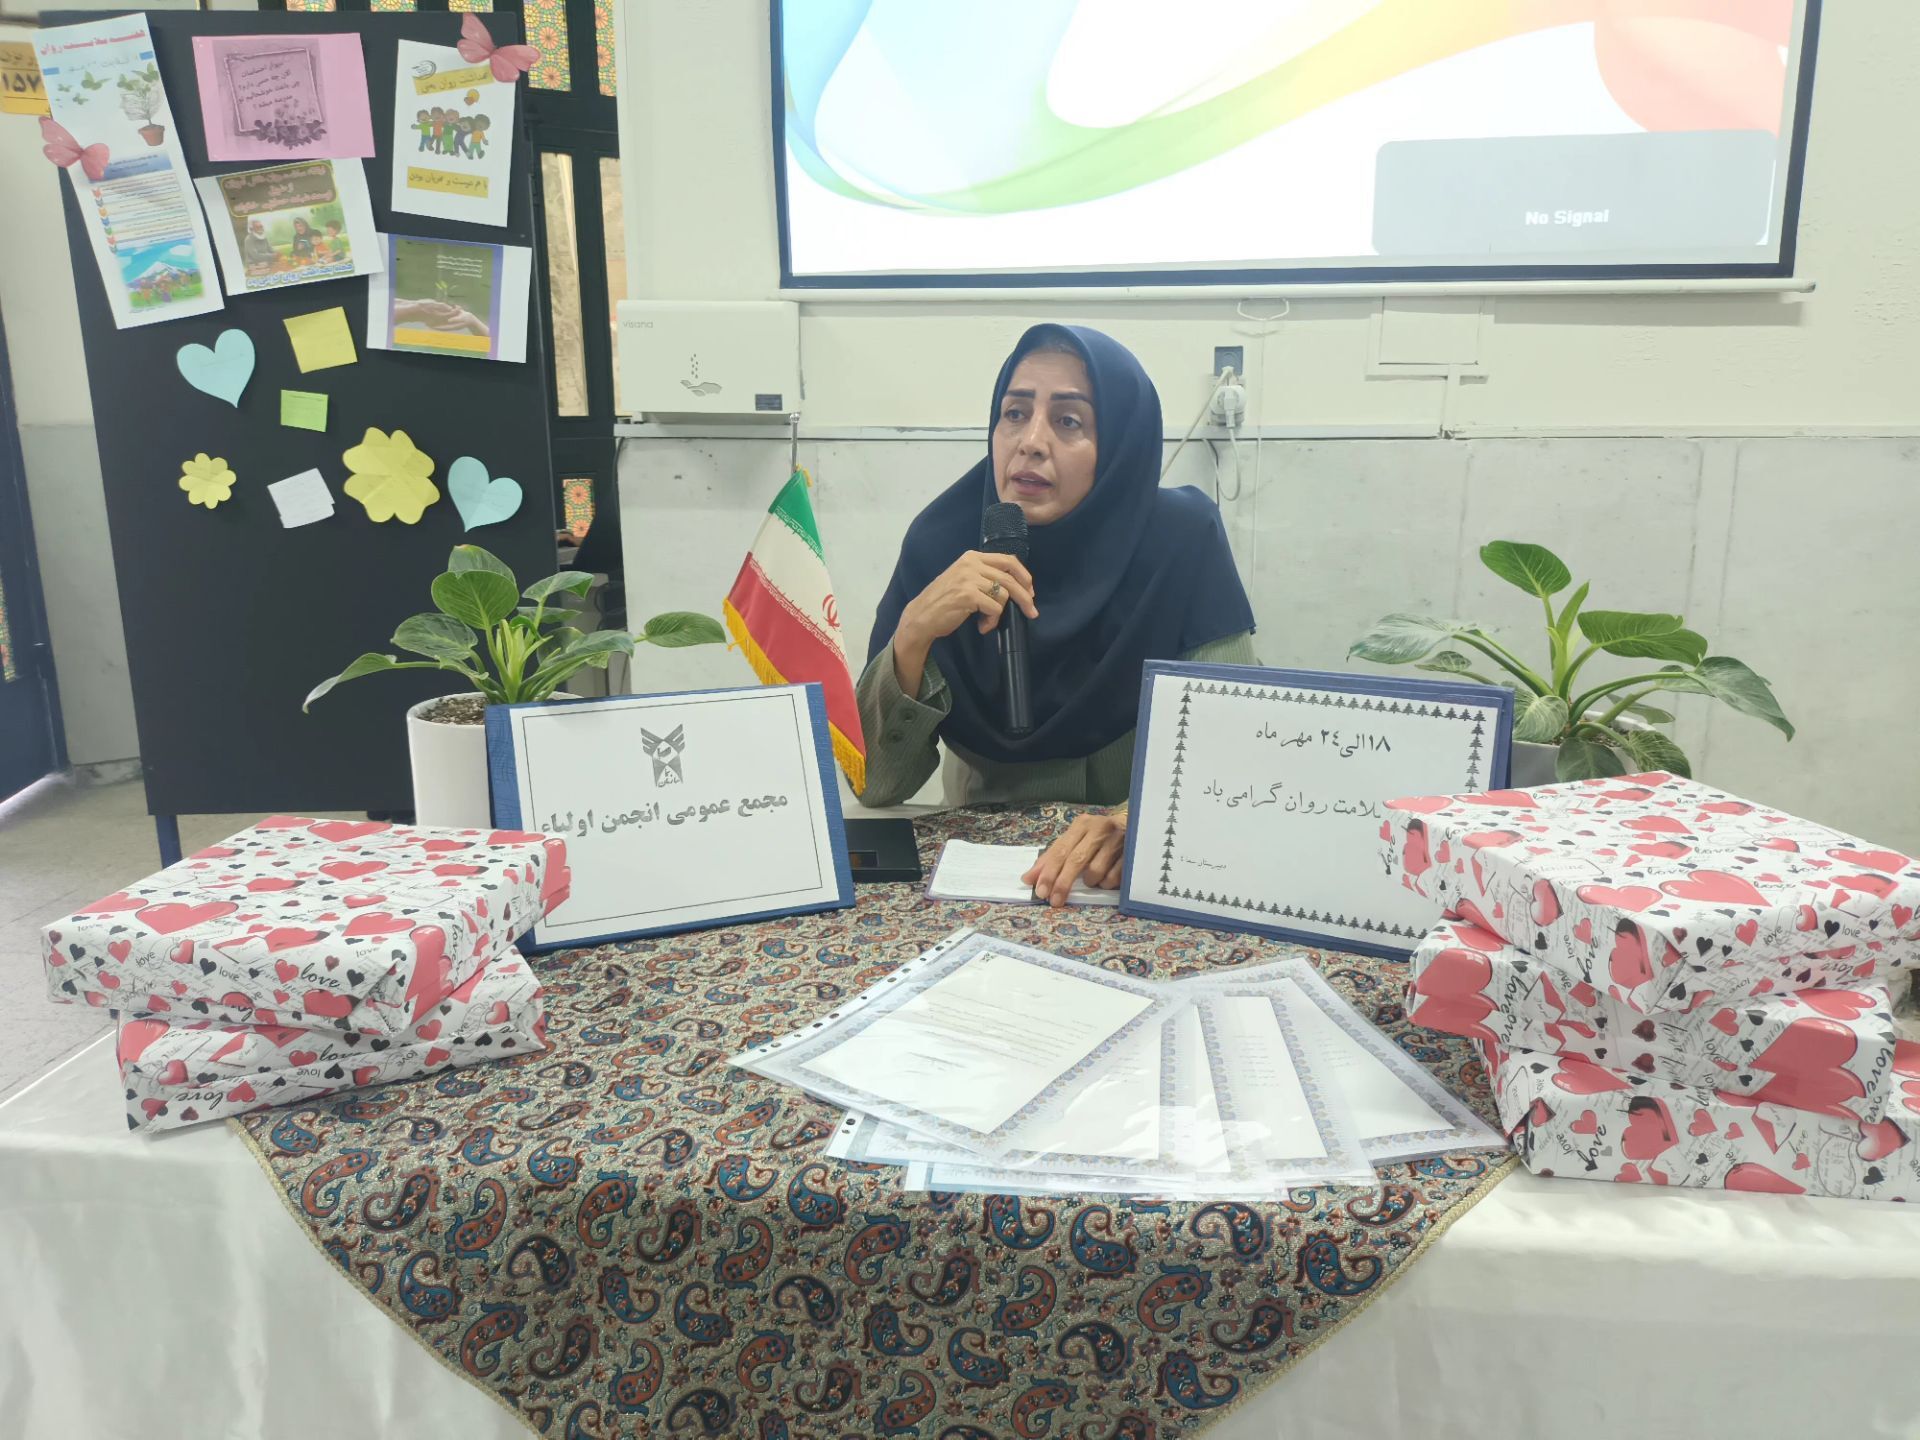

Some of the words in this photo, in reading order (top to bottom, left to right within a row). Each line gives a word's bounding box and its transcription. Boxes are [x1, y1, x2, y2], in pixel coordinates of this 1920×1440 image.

[1525, 211, 1549, 225] No
[1554, 209, 1609, 228] Signal
[1203, 779, 1224, 803] باد
[1226, 781, 1284, 808] گرامی
[1284, 791, 1328, 815] روان
[601, 802, 661, 834] انجمن
[666, 799, 731, 826] عمومی
[737, 795, 788, 818] مجمع
[1763, 924, 1783, 947] love
[1842, 923, 1861, 938] love
[1563, 934, 1575, 959] love
[218, 966, 240, 983] love
[301, 962, 341, 988] love
[297, 1067, 321, 1078] love
[174, 1090, 225, 1111] love
[1556, 1132, 1574, 1156] love
